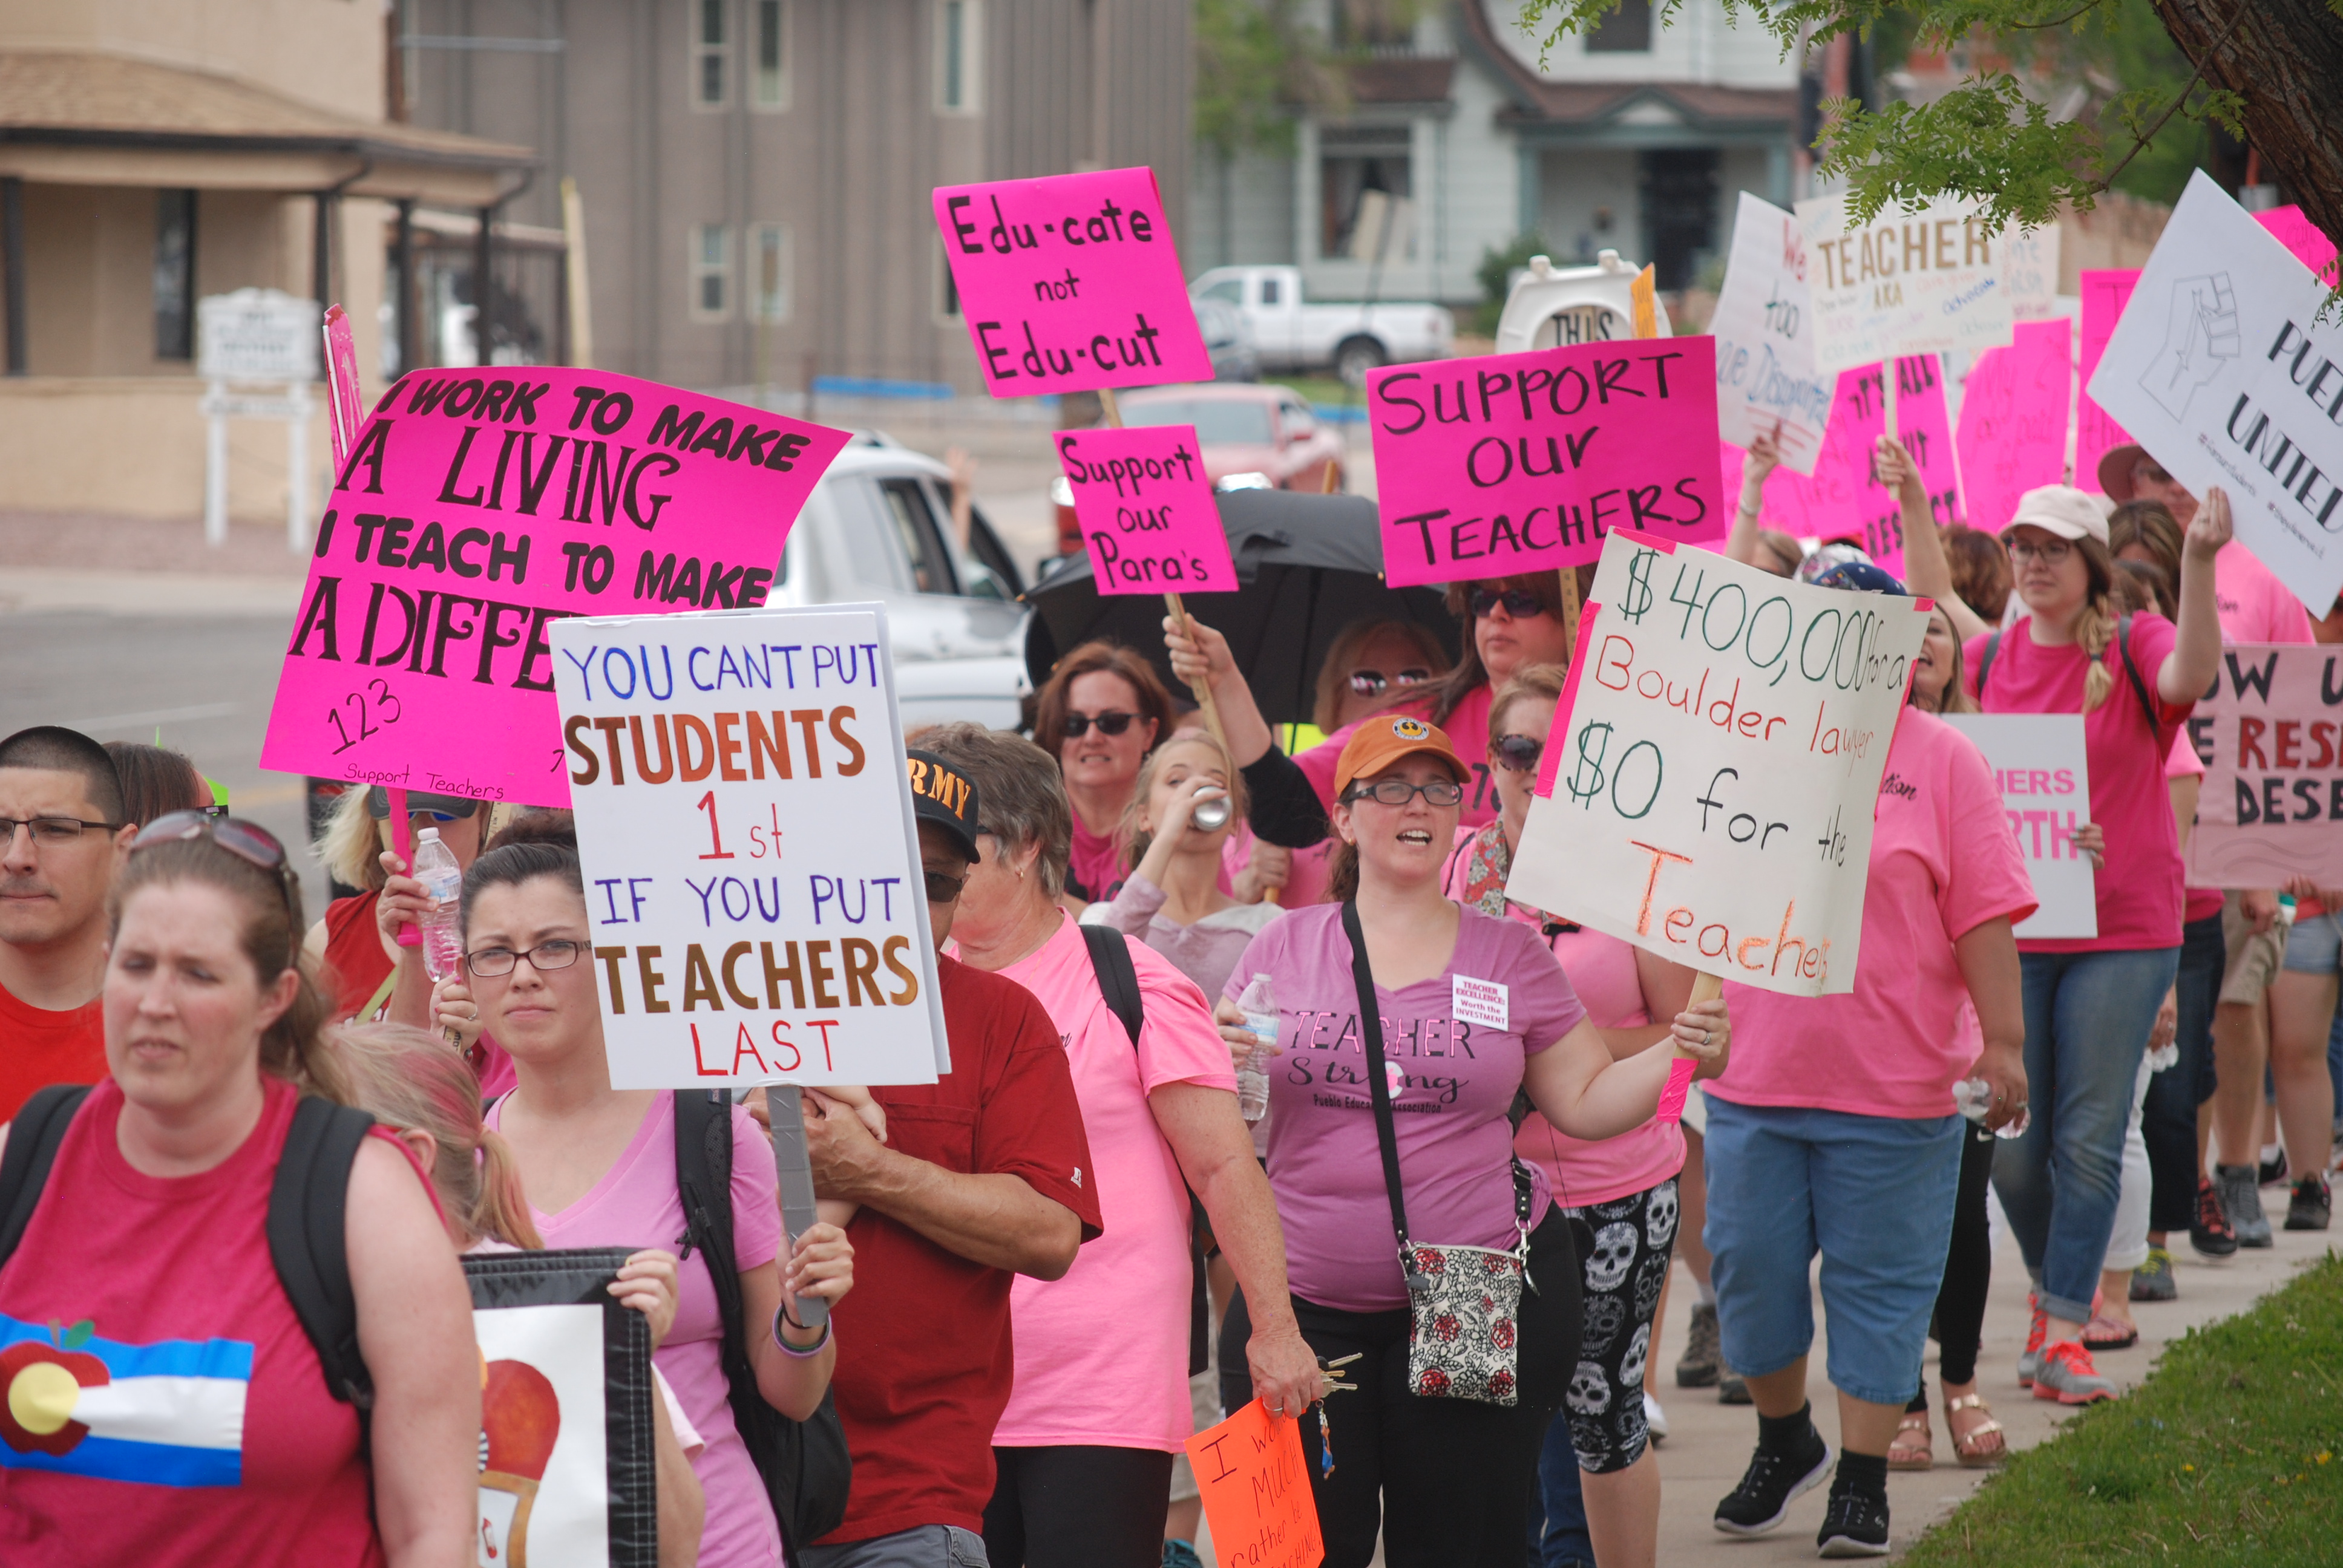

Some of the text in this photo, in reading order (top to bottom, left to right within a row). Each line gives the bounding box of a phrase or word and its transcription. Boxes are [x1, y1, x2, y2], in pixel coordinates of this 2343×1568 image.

[1818, 217, 1990, 290] TEACHER
[1034, 268, 1081, 302] not
[1552, 312, 1613, 347] THIS
[1378, 353, 1683, 435] SUPPORT
[377, 378, 812, 473] I WORK TO MAKE
[335, 419, 681, 532] A LIVING
[1061, 437, 1193, 498] Support
[1117, 503, 1172, 534] our
[1394, 478, 1706, 565] TEACHERS
[315, 510, 773, 607] I TEACH TO MAKE
[1090, 531, 1208, 588] Para's
[288, 576, 342, 661] A
[562, 644, 877, 701] YOU CANT PUT
[1888, 653, 1905, 690] a
[2199, 652, 2278, 705] W
[327, 678, 401, 755] 123
[1596, 635, 1873, 777] Boulder lawyer
[563, 705, 865, 786] STUDENTS
[344, 763, 503, 800] Support Teachers
[1567, 719, 1662, 820] $0
[1697, 768, 1788, 850] for
[1818, 805, 1846, 866] the
[595, 875, 900, 927] IF YOU PUT
[595, 935, 918, 1015] TEACHERS
[1456, 988, 1505, 1005] EXCELLENCE:
[1463, 981, 1498, 995] TEACHER
[1457, 1007, 1505, 1024] INVESTMENT
[1461, 999, 1501, 1014] Worth the
[690, 1019, 839, 1077] LAST
[1313, 1094, 1341, 1108] Pueblo
[1392, 1100, 1441, 1114] Association
[1200, 1433, 1237, 1483] I
[1252, 1436, 1300, 1518] MUCH
[1231, 1499, 1303, 1568] rather be
